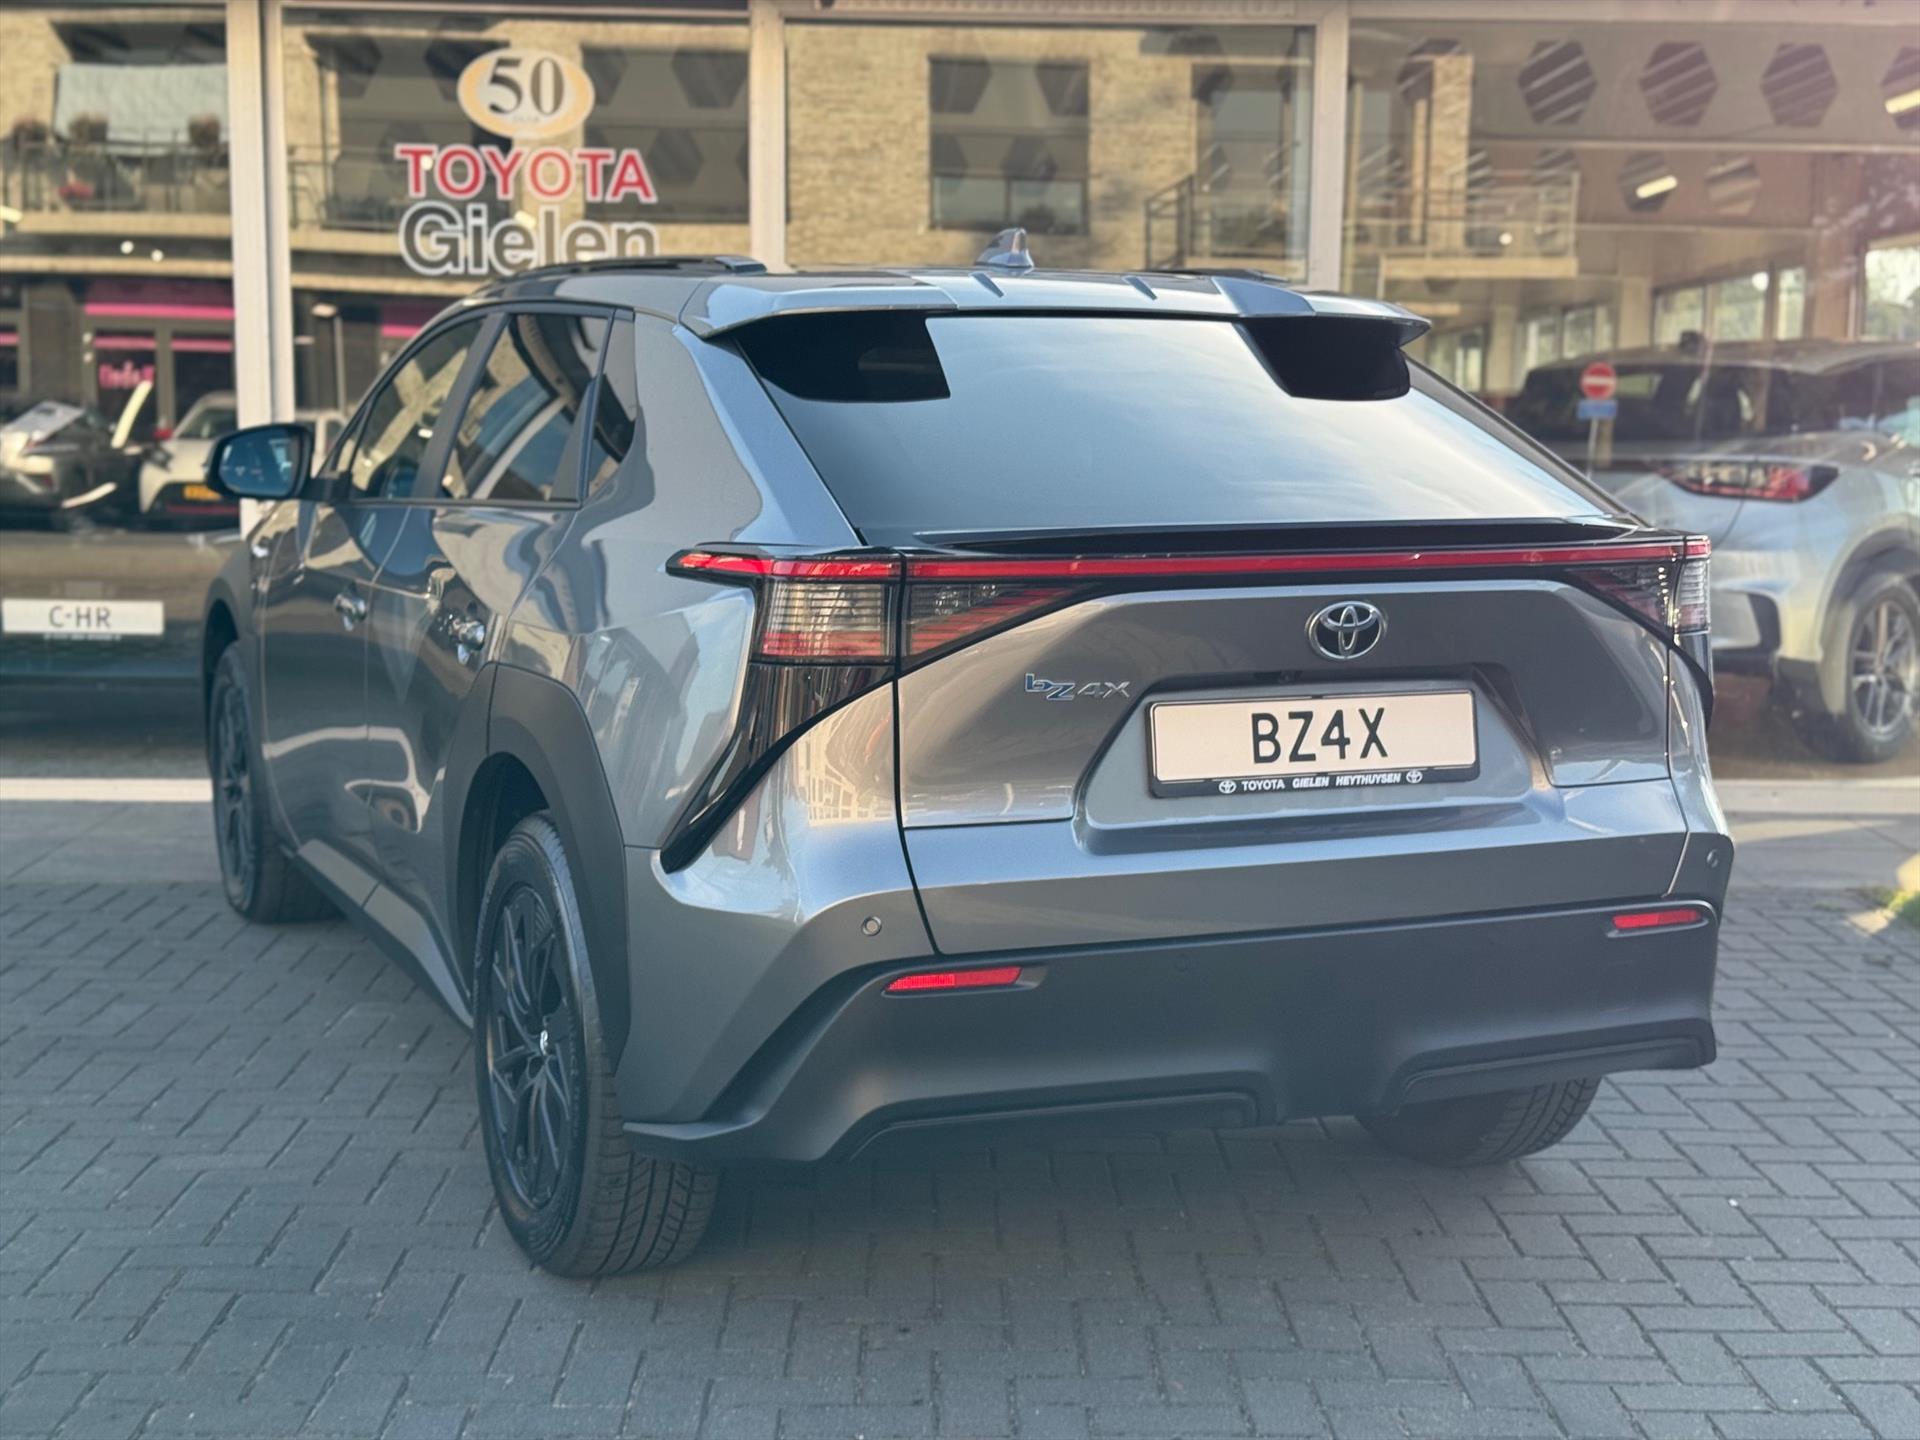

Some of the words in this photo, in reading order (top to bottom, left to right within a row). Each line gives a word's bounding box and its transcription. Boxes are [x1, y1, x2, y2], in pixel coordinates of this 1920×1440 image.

[488, 57, 565, 115] 50
[395, 145, 658, 203] TOYOTA
[399, 201, 660, 274] Gielen
[49, 606, 111, 628] C-HR
[1251, 707, 1388, 764] BZ4X
[1241, 780, 1285, 795] TOYOTA
[1292, 775, 1329, 789] GIELEN
[1336, 773, 1401, 787] HEYTHUYSEN
